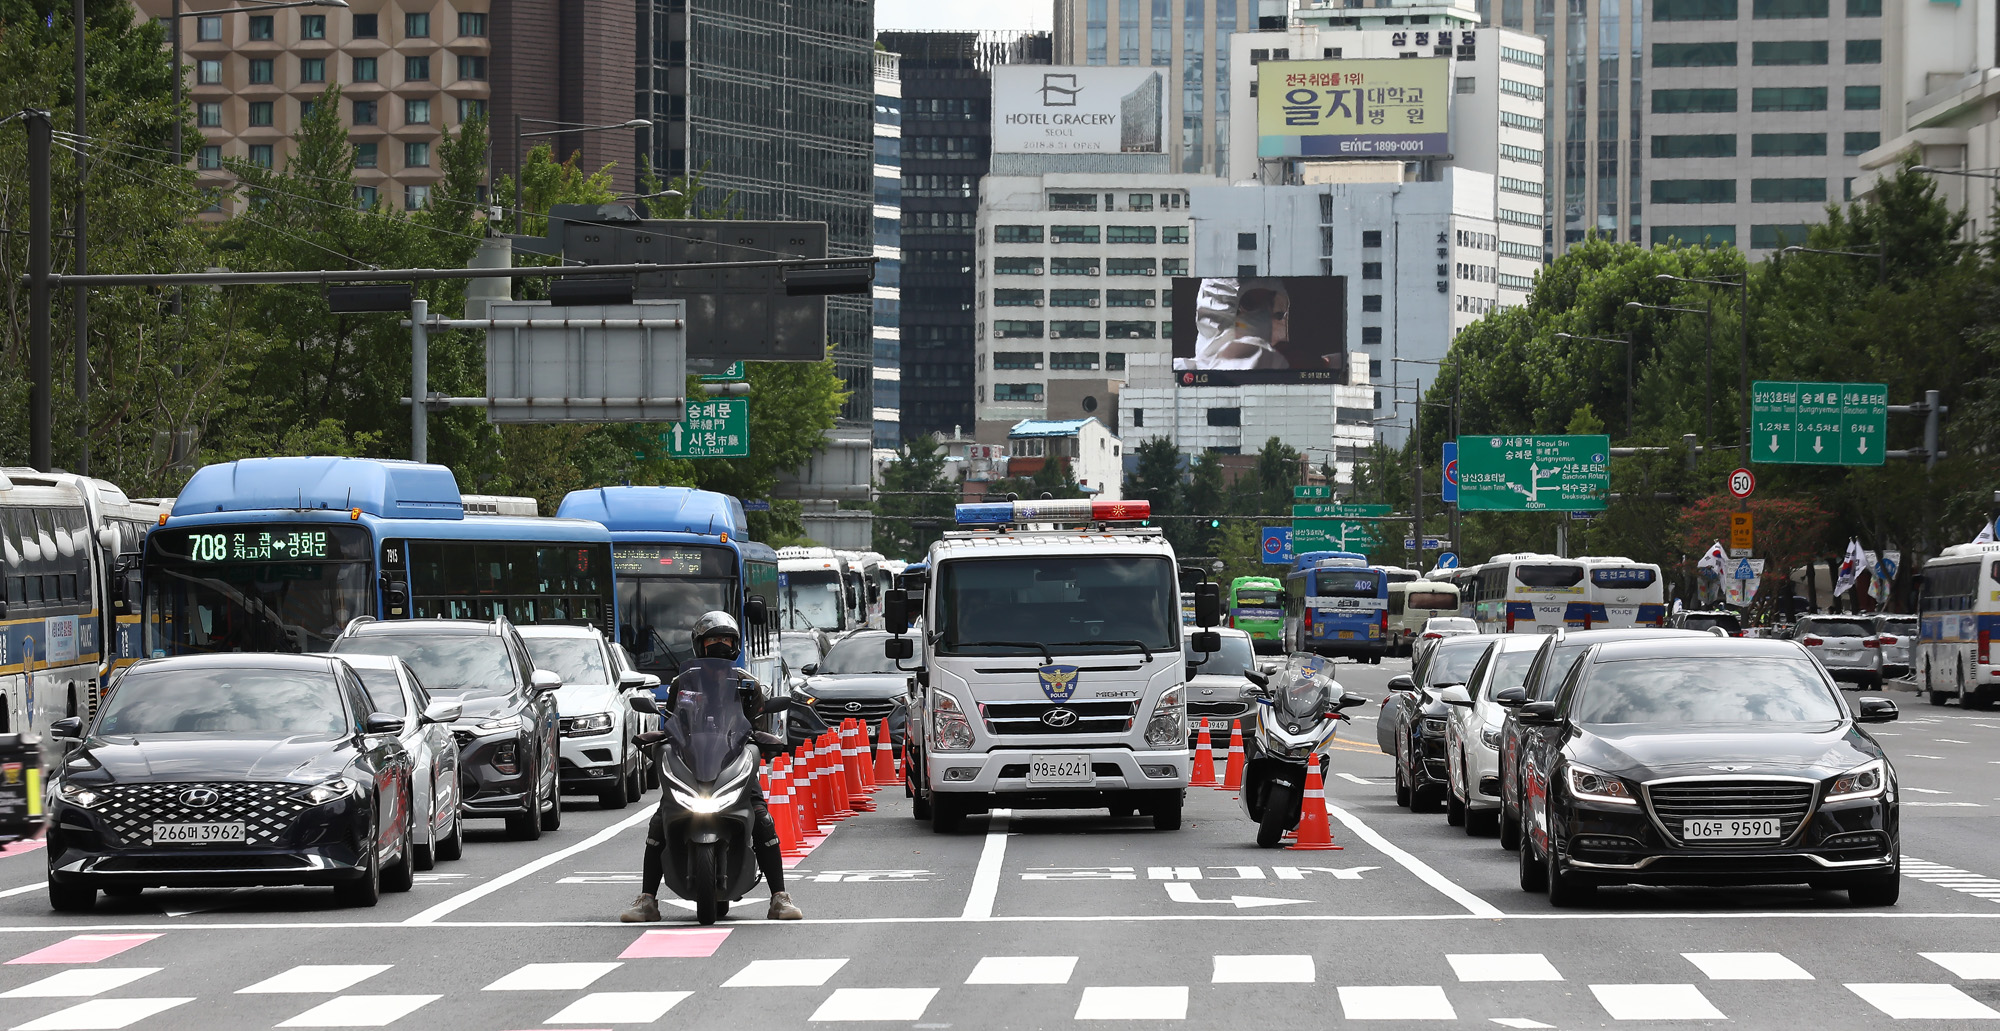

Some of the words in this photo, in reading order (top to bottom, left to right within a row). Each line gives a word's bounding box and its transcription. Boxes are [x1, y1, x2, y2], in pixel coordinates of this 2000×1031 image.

[1392, 31, 1475, 46] 삼정빌딩
[1285, 73, 1307, 87] 전국
[1308, 72, 1341, 87] 취업률
[1344, 72, 1364, 86] 1위!
[1282, 88, 1364, 126] 을지
[1367, 87, 1424, 104] 대학교
[1005, 113, 1049, 125] HOTEL
[1052, 113, 1116, 125] GRACERY
[1045, 128, 1074, 137] SEOUL
[1073, 141, 1101, 149] OPEN
[1195, 374, 1209, 384] LG
[1754, 391, 1796, 404] 남산3호터널
[1801, 392, 1838, 404] 숭례문
[1843, 393, 1885, 405] 신촌로터리
[688, 403, 731, 419] 숭례문
[1799, 405, 1840, 415] Sungnyemun
[1797, 422, 1839, 432] 3.4.5차로
[1851, 423, 1875, 433] 6차로
[689, 432, 716, 447] 시청
[1505, 437, 1533, 447] 서울역
[689, 447, 705, 456] City
[1505, 450, 1532, 460] 숭례문
[1562, 463, 1606, 473] 신촌로터리
[1461, 473, 1506, 482] 남산3호터널
[1733, 476, 1749, 491] 50
[188, 533, 227, 560] 708
[287, 532, 326, 557] 광화문
[233, 546, 271, 559] 차고지
[1354, 581, 1372, 590] 402
[1096, 690, 1139, 698] MIGHTY
[1731, 821, 1772, 836] 9590
